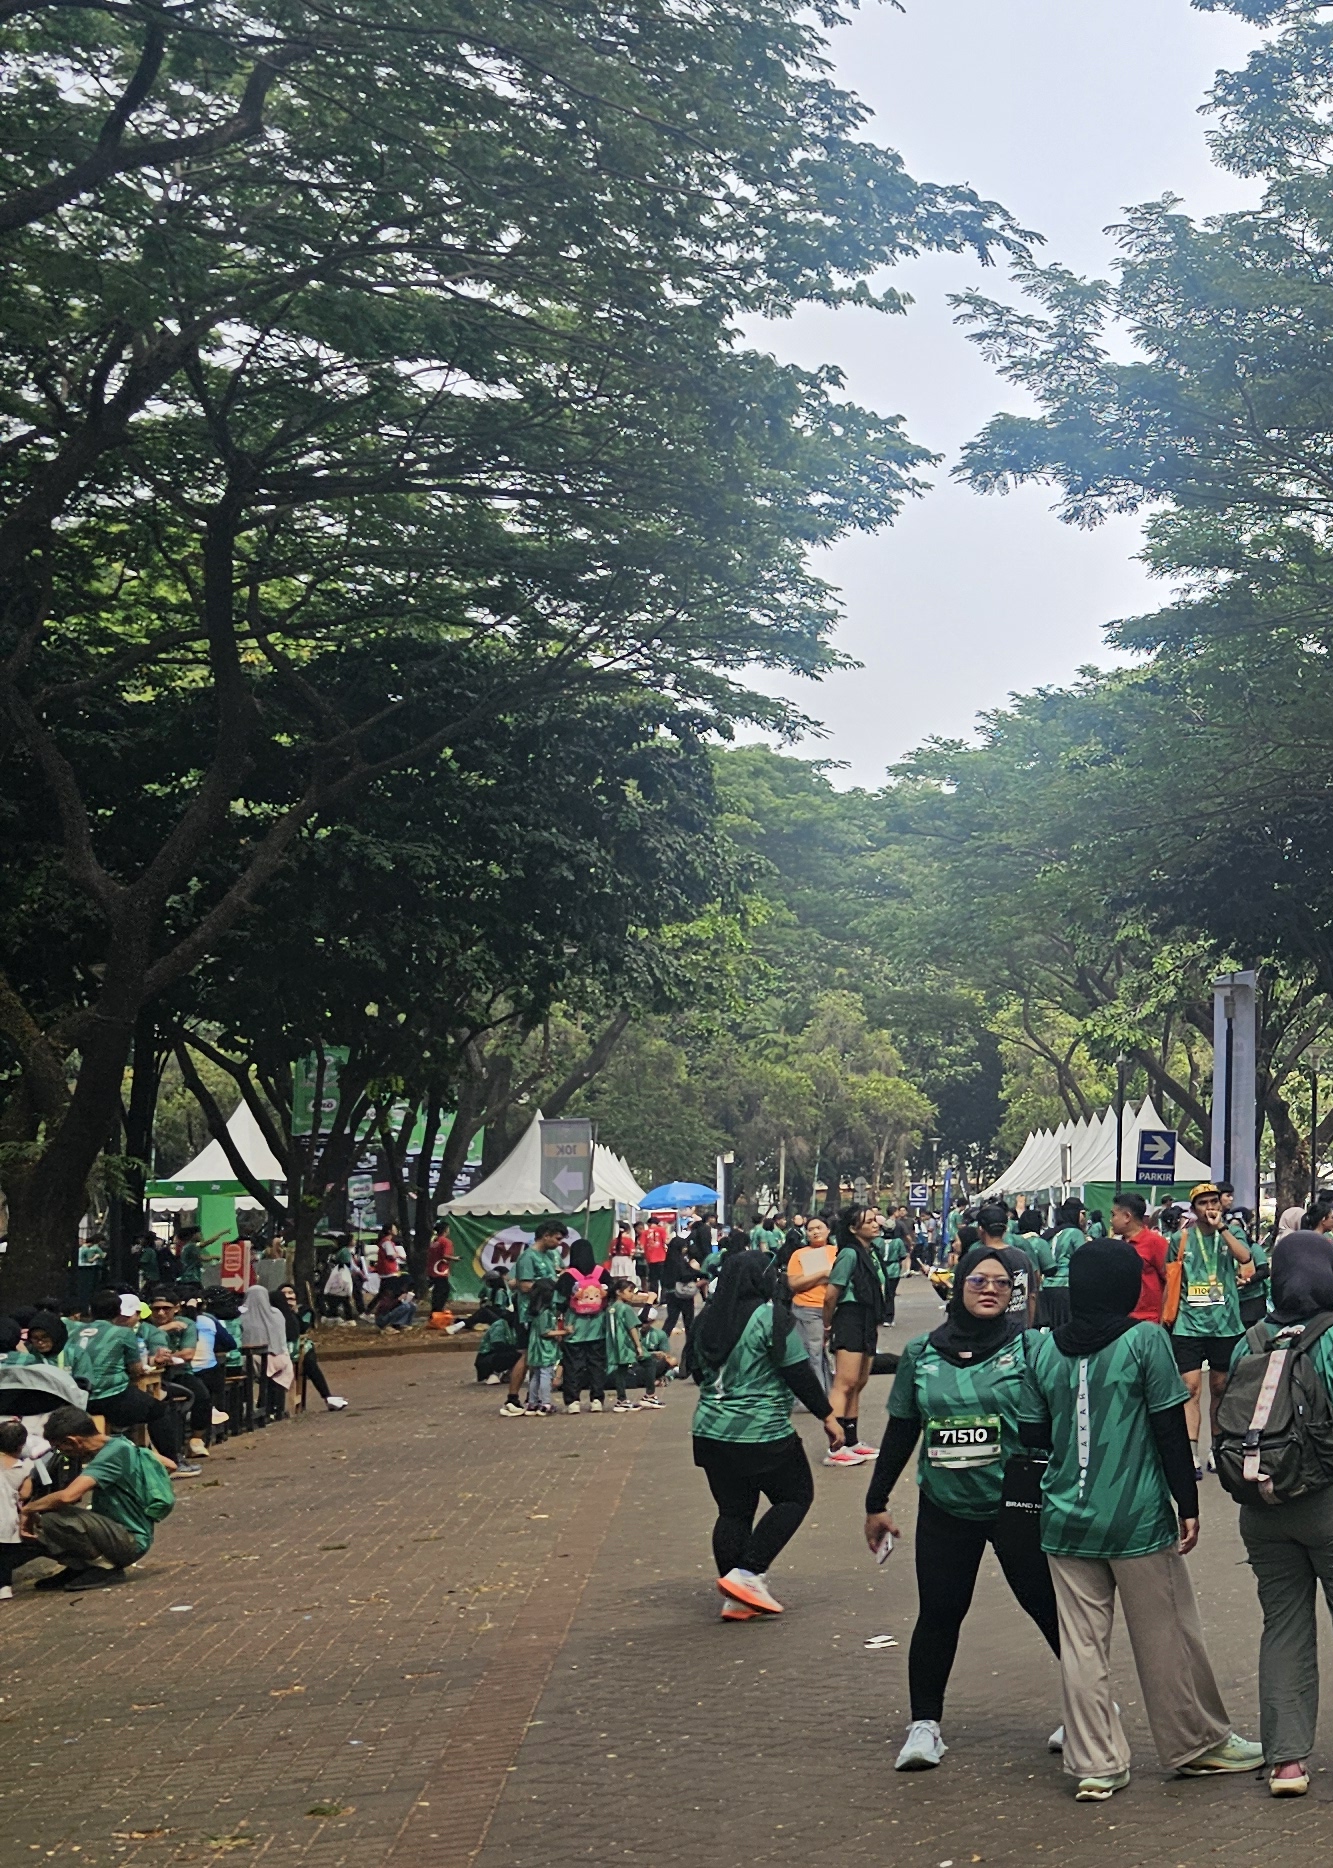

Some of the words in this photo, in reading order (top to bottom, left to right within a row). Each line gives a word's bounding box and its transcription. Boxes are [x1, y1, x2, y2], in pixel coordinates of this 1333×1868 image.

[1138, 1172, 1173, 1182] PARKIR
[1193, 1287, 1212, 1295] 110
[939, 1428, 988, 1444] 71510
[1005, 1500, 1034, 1509] BRAND
